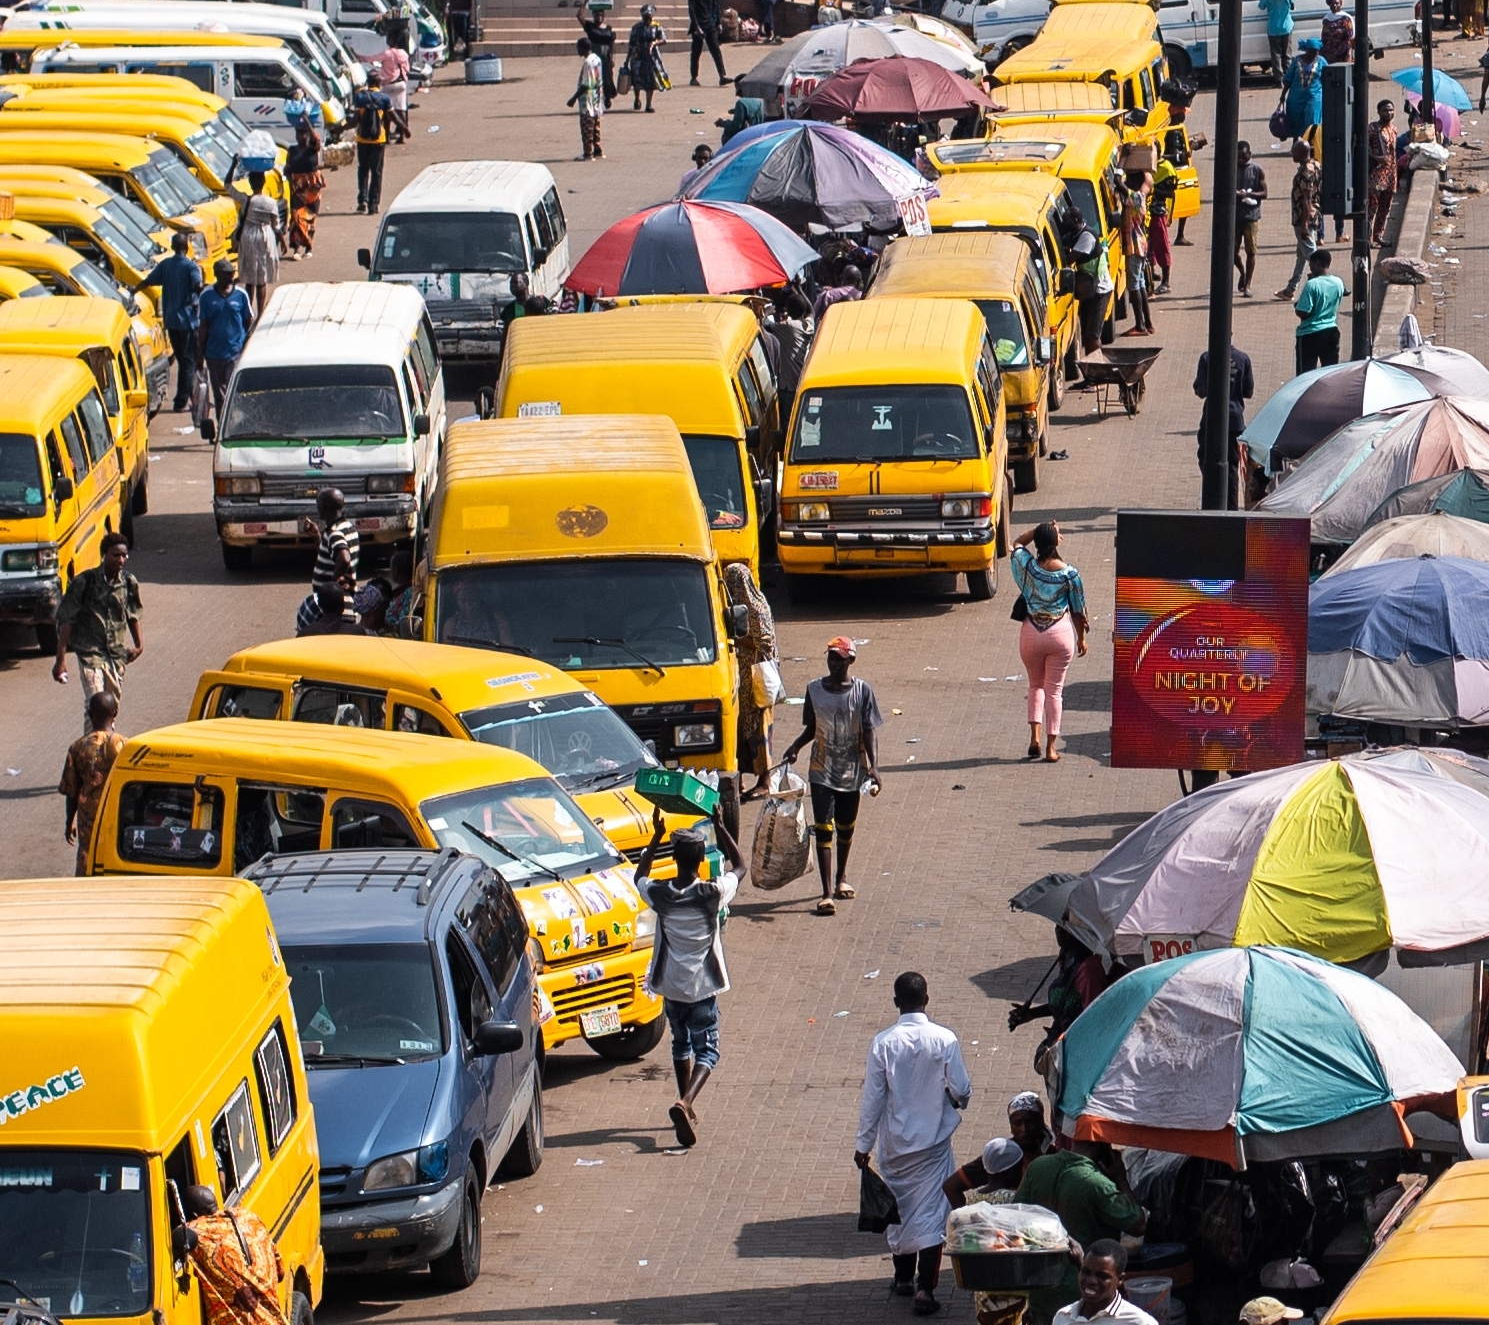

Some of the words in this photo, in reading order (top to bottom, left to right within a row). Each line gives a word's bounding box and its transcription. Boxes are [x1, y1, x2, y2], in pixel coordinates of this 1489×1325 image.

[900, 196, 926, 226] POS
[868, 508, 903, 516] mazda
[1196, 637, 1225, 646] OUR
[1169, 647, 1249, 660] QUARTERLY
[1154, 672, 1233, 691] NIGHT
[1238, 674, 1272, 693] OF
[1188, 696, 1237, 716] JOY
